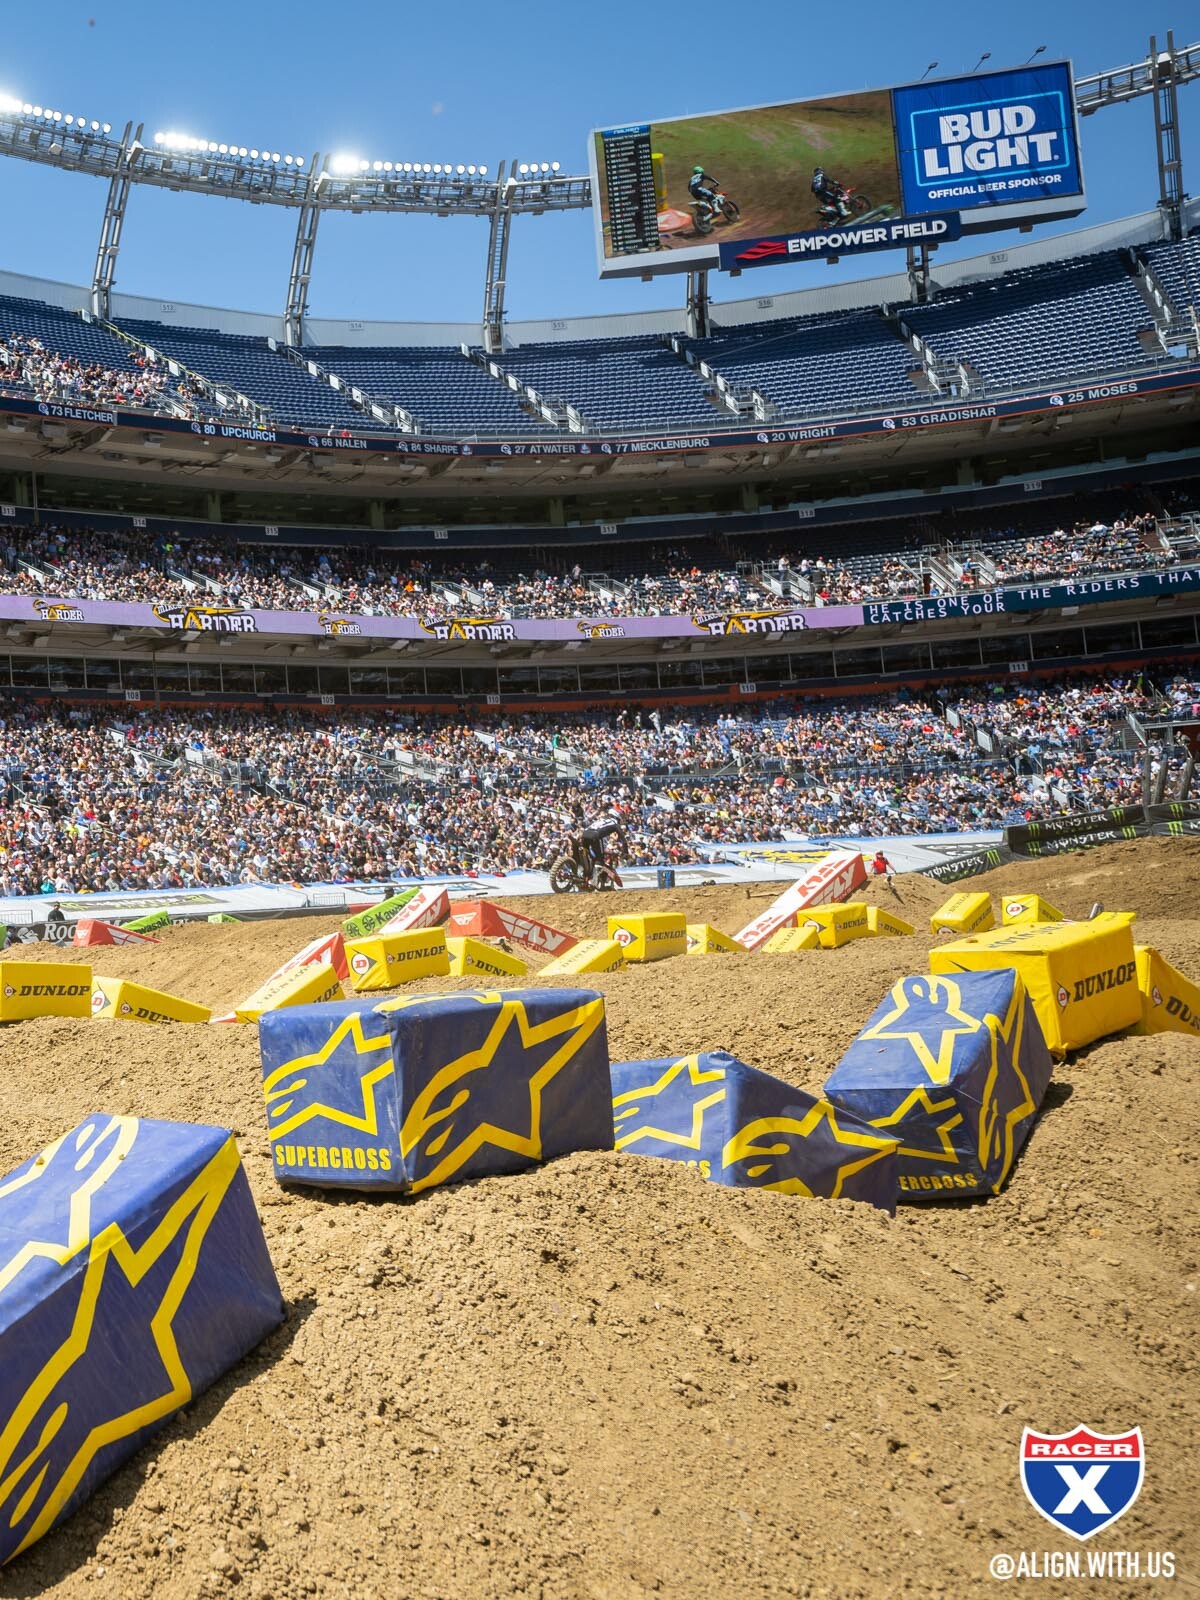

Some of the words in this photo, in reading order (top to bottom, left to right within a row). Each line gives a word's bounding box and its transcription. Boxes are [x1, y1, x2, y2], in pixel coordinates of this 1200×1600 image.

[938, 105, 1035, 145] BUD
[924, 131, 1057, 179] LIGHT
[928, 186, 975, 200] OFFICIAL
[978, 182, 1006, 193] BEER
[1007, 175, 1062, 190] SPONSOR
[787, 227, 888, 254] EMPOWER
[892, 220, 947, 238] FIELD
[1068, 392, 1084, 402] 25
[1088, 382, 1138, 401] MOSES
[50, 405, 63, 417] 73
[64, 407, 114, 423] FLETCHER
[902, 416, 917, 427] 53
[920, 406, 997, 424] GRADISHAR
[204, 424, 216, 436] 80
[221, 427, 276, 443] UPCHURCH
[771, 431, 785, 442] 20
[788, 426, 837, 440] WRIGHT
[321, 437, 333, 448] 66
[335, 438, 367, 449] NALEN
[424, 444, 459, 455] SHARPE
[514, 445, 526, 454] 27
[529, 444, 576, 455] ATWATER
[616, 443, 628, 453] 77
[631, 437, 710, 453] MECKLENBURG
[869, 603, 888, 614] HE
[903, 600, 923, 611] IS
[936, 596, 969, 608] ONE
[983, 593, 1002, 604] OF
[1018, 588, 1051, 600] THE
[1066, 577, 1140, 595] RIDERS
[1154, 569, 1200, 585] THAT
[41, 607, 84, 621] HARDER
[870, 607, 948, 625] CATCHES
[962, 602, 1006, 615] YOUR
[169, 614, 256, 632] HARDER
[324, 622, 361, 635] HARDER
[434, 623, 515, 641] HARDER
[584, 625, 625, 637] HARDER
[708, 615, 806, 635] HARDER
[126, 690, 140, 700] 108
[321, 695, 334, 704] 109
[1045, 813, 1108, 830] MONSTER
[1046, 830, 1117, 850] MONSTER
[923, 855, 984, 878] MONSTER
[396, 945, 446, 963] DUNLOP
[1073, 960, 1136, 1003] DUNLOP
[19, 985, 90, 997] DUNLOP
[313, 982, 340, 1003] LOP
[135, 1007, 178, 1024] DUN
[1165, 995, 1200, 1031] DUN
[275, 1144, 392, 1171] SUPERCROSS
[900, 1172, 978, 1192] ERCROSS
